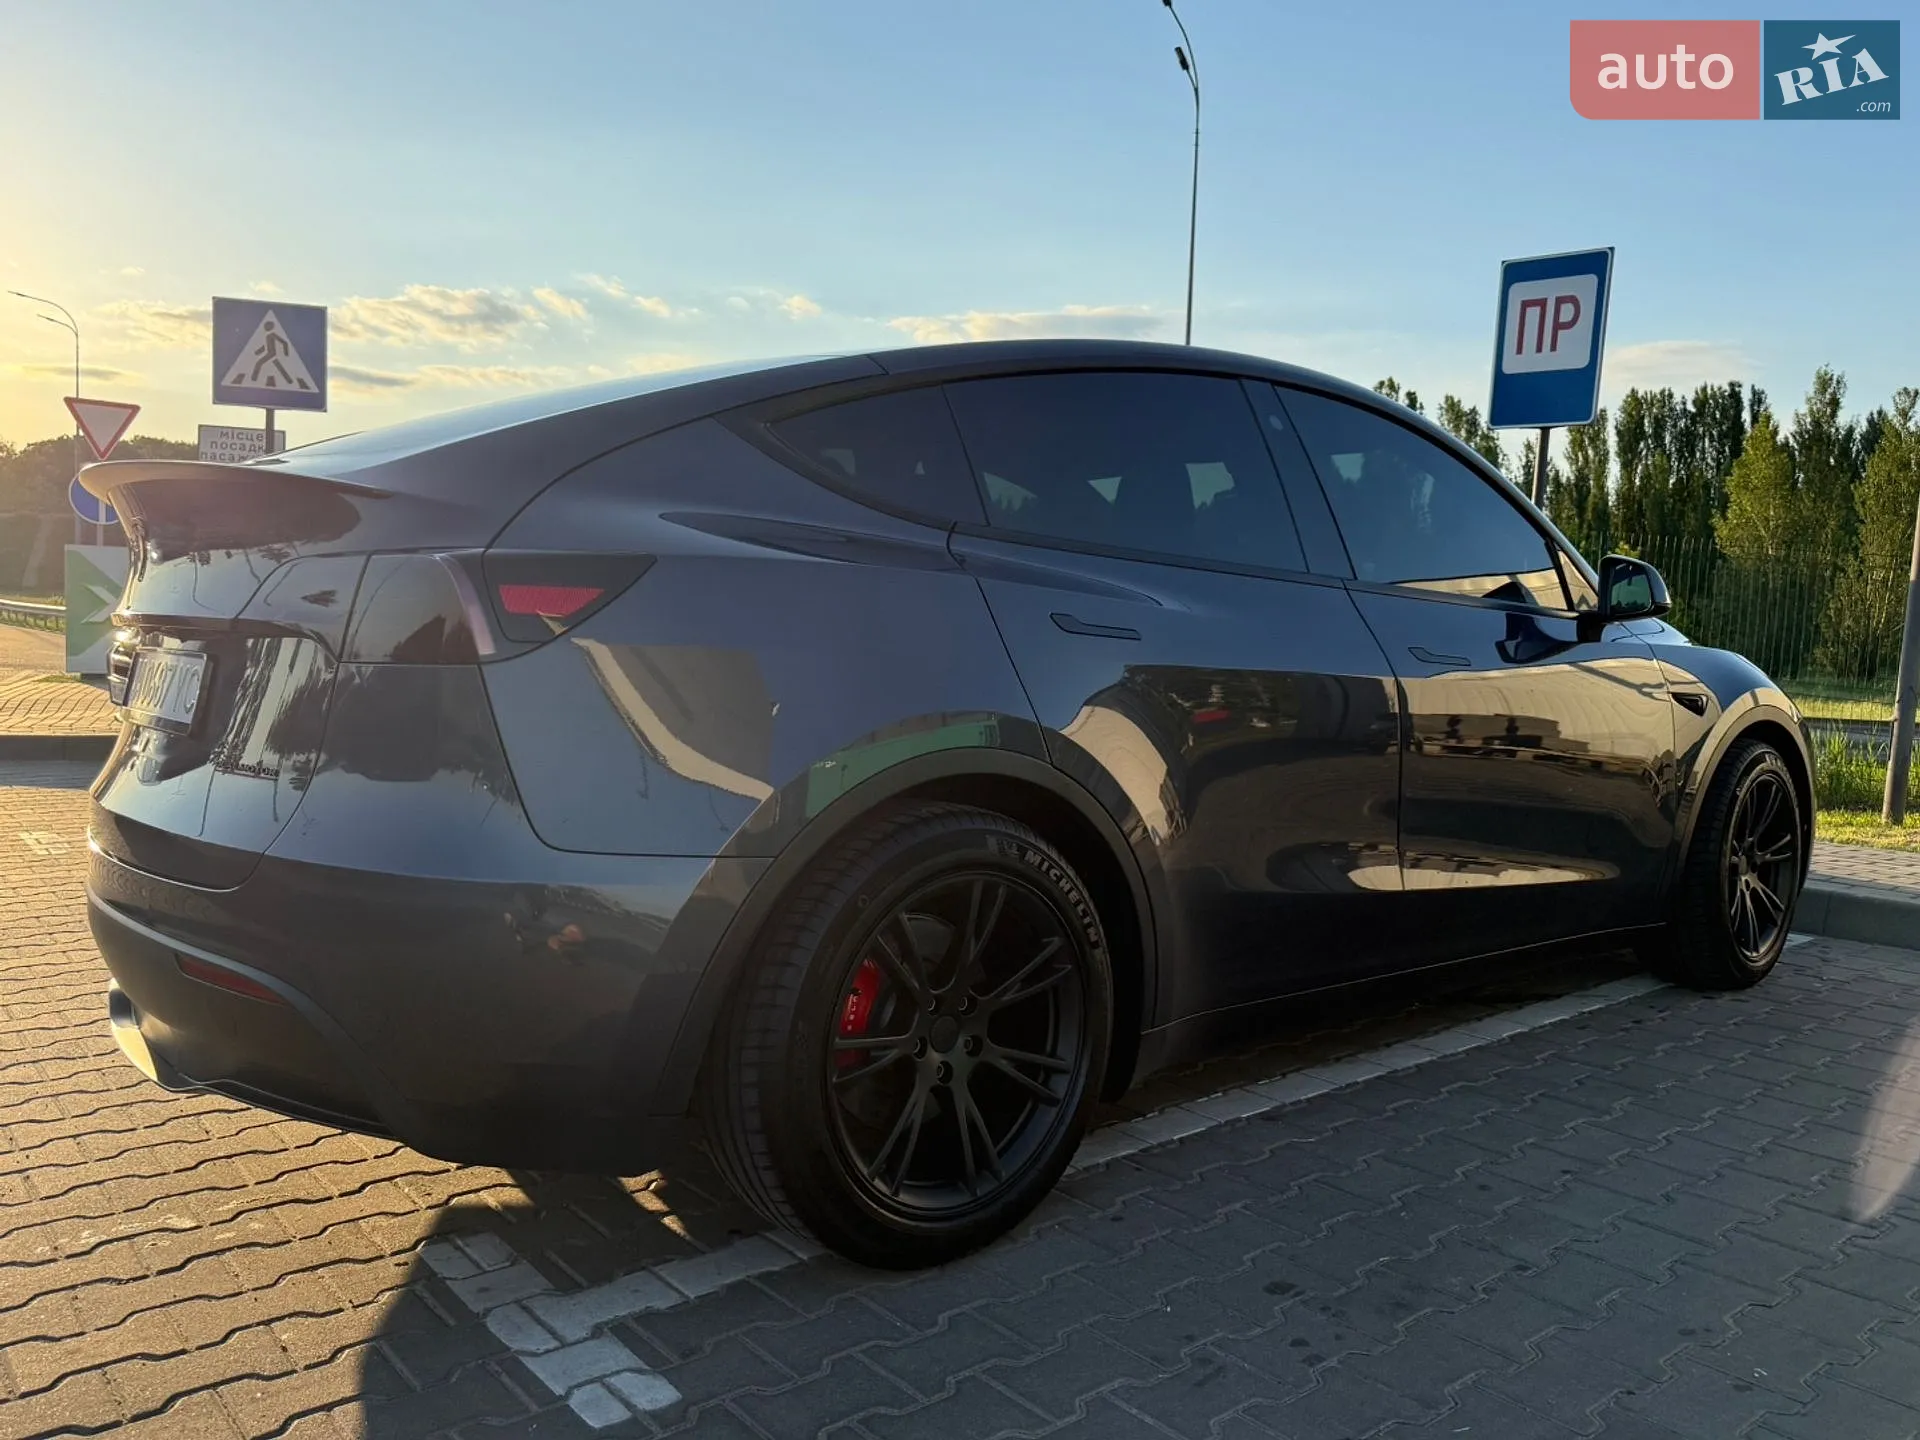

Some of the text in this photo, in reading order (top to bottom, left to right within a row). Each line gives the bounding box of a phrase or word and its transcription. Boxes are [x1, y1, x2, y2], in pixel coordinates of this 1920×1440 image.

[1515, 294, 1581, 355] ПР
[210, 441, 265, 453] посадк
[1023, 849, 1100, 943] MICHELIN
